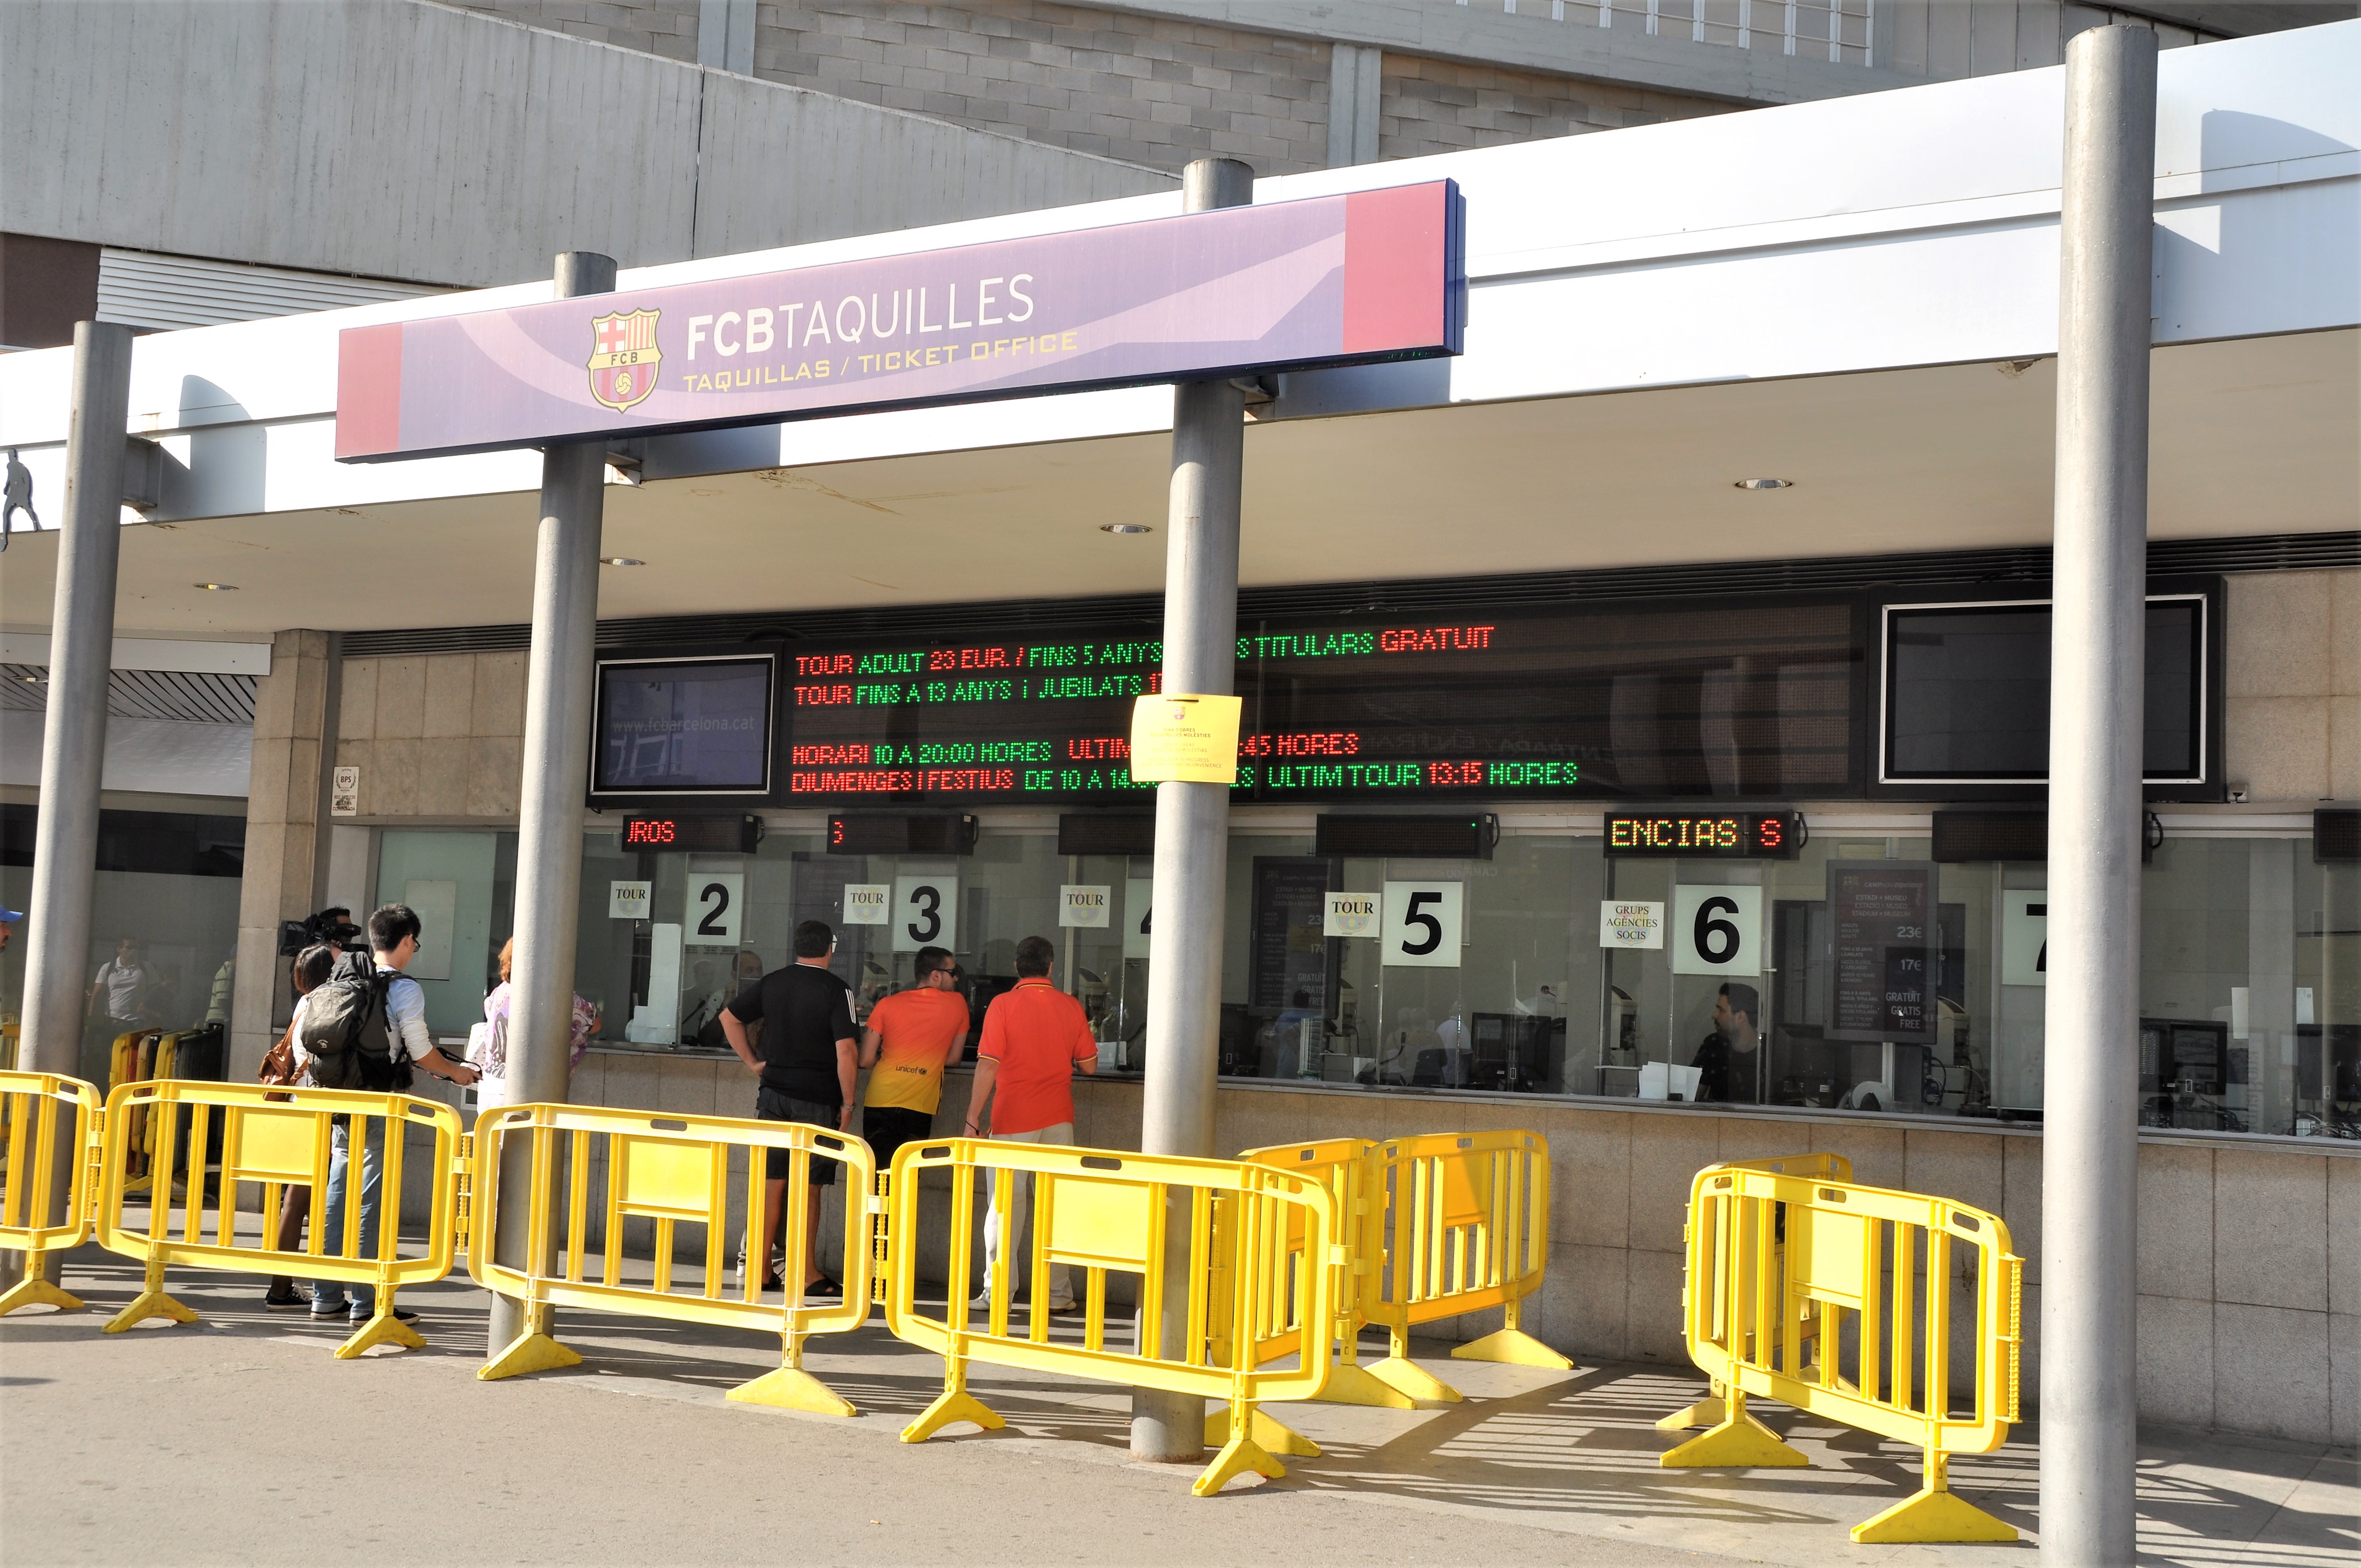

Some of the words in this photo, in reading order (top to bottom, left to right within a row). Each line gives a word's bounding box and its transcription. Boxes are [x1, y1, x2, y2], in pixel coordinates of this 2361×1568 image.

[611, 352, 638, 366] FCB
[683, 360, 830, 392] TAQUILLAS
[857, 345, 959, 373] TICKET
[971, 331, 1078, 360] OFFICE
[1254, 633, 1374, 657] TITULARS
[1380, 626, 1495, 652] GRATUIT
[796, 655, 853, 676] TOUR
[858, 652, 925, 674] ADULT
[930, 650, 956, 670] 23
[1029, 646, 1077, 667] FINS
[1084, 645, 1094, 665] 5
[1100, 641, 1163, 665] ANYS
[793, 684, 852, 705] TOUR
[856, 684, 901, 705] FINS
[906, 683, 921, 703] A
[927, 682, 946, 702] 13
[952, 680, 1011, 701] ANYS
[1038, 675, 1142, 699] JUBILATS
[612, 716, 754, 732] www.fcbarcelona.cat
[1278, 733, 1359, 755] HORES
[792, 744, 869, 765] HORARI
[874, 745, 893, 765] 10
[899, 745, 913, 764] A
[918, 743, 975, 764] 20:00
[981, 742, 1052, 763] HORES
[791, 771, 913, 792] DIUMENGES
[928, 769, 1014, 790] FESTIUS
[1025, 770, 1053, 790] DE
[1060, 770, 1081, 790] 10
[1087, 769, 1102, 789] A
[1268, 765, 1342, 787] ULTIM
[1347, 764, 1421, 787] TOUR
[1428, 761, 1483, 784] 13:15
[1489, 762, 1577, 785] HORES
[1612, 819, 1737, 846] ENCIAS
[616, 889, 645, 899] TOUR
[851, 893, 884, 904] TOUR
[1067, 894, 1104, 906] TOUR
[698, 883, 729, 935] 2
[908, 886, 941, 943] 3
[1332, 901, 1374, 914] TOUR
[1615, 906, 1649, 914] GRUPS
[1401, 892, 1442, 955] 5
[1606, 916, 1657, 928] AGÈNCIES
[1617, 930, 1646, 940] SOCIS
[1694, 896, 1740, 964] 6
[1897, 925, 1922, 938] 23€
[1900, 959, 1922, 971] 17€
[1885, 990, 1921, 1003] GRATUÏT
[1891, 1005, 1921, 1016] GRATIS
[1900, 1020, 1921, 1028] FREE
[895, 1065, 918, 1074] unicef
